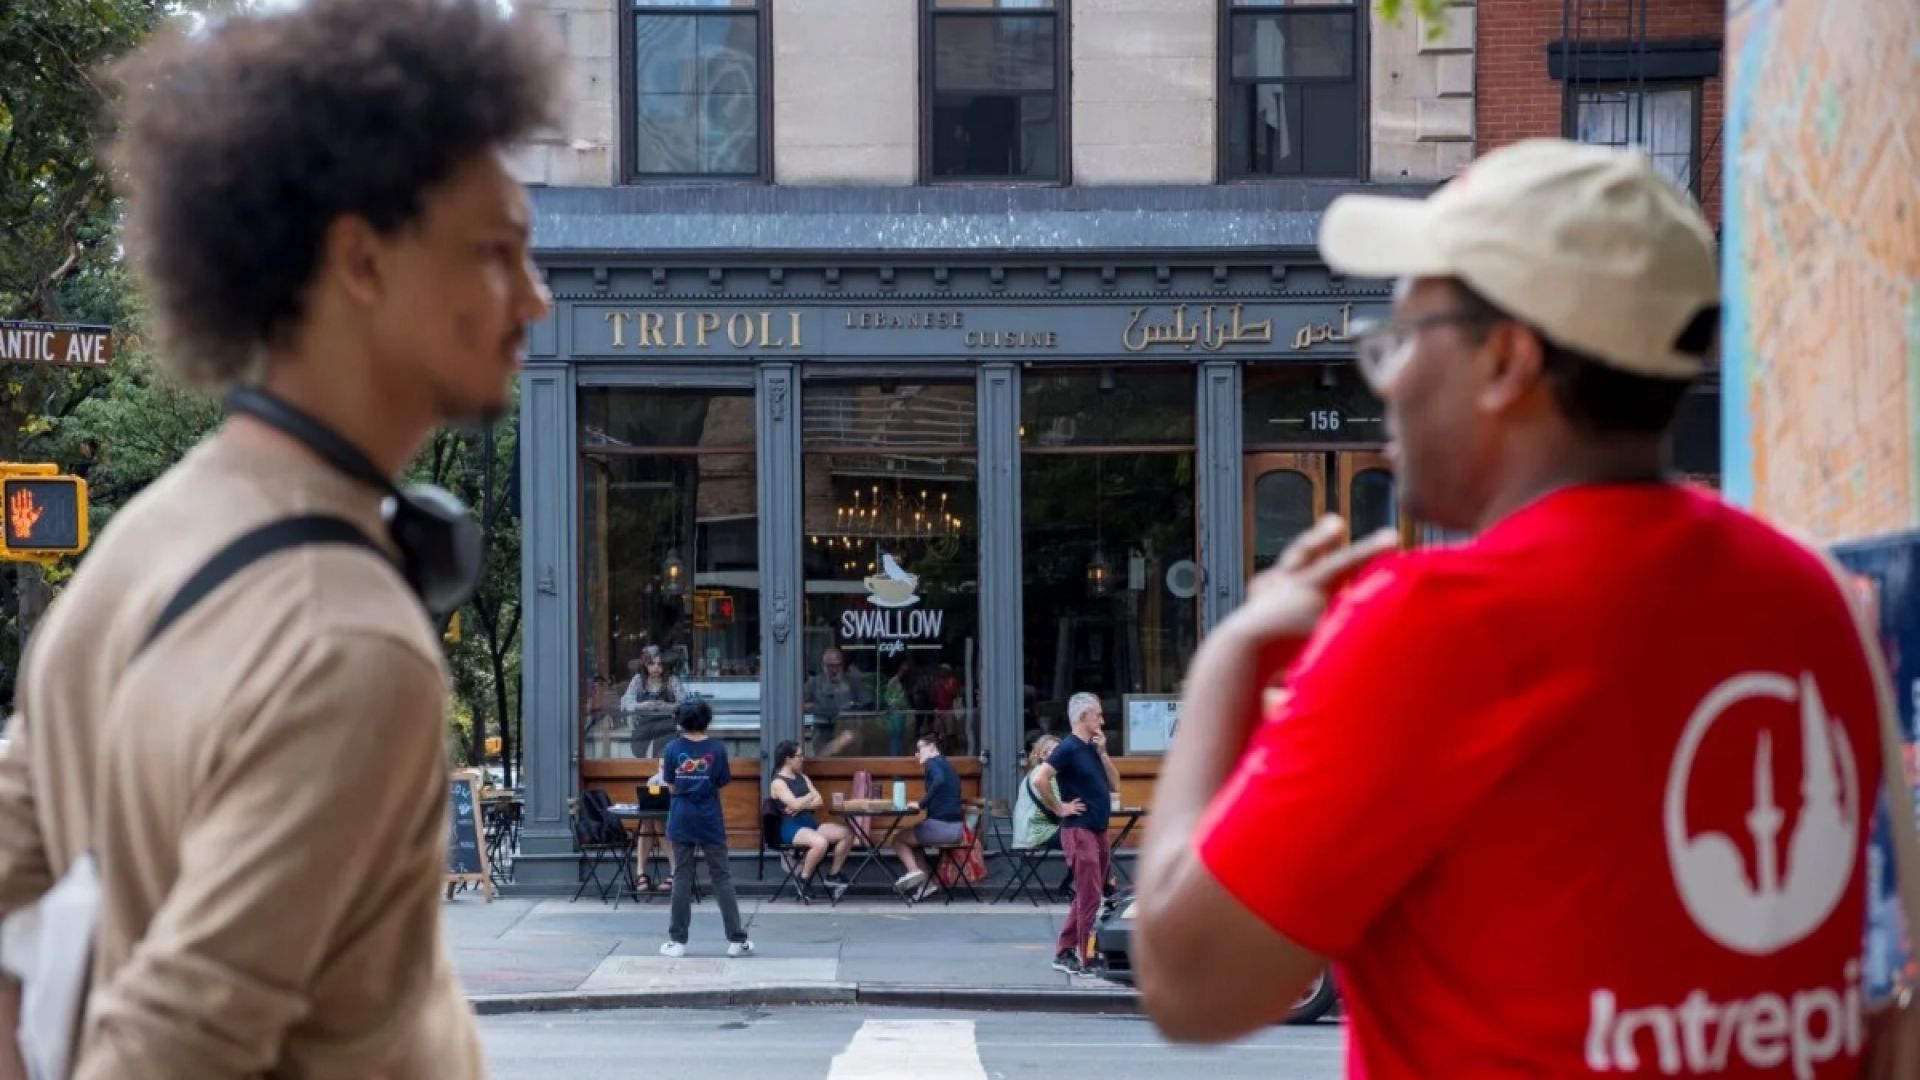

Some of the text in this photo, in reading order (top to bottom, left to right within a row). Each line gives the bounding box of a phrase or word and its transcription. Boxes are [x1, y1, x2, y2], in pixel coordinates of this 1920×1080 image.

[605, 311, 803, 349] TRIPOLI
[845, 311, 964, 329] LEBANESE
[1123, 303, 1272, 351] طرابلس
[66, 332, 107, 364] AVE
[964, 331, 1057, 348] CUISINE
[1309, 410, 1340, 431] 156
[841, 609, 943, 639] SWALLOW
[1585, 957, 1867, 1080] Intrepi
